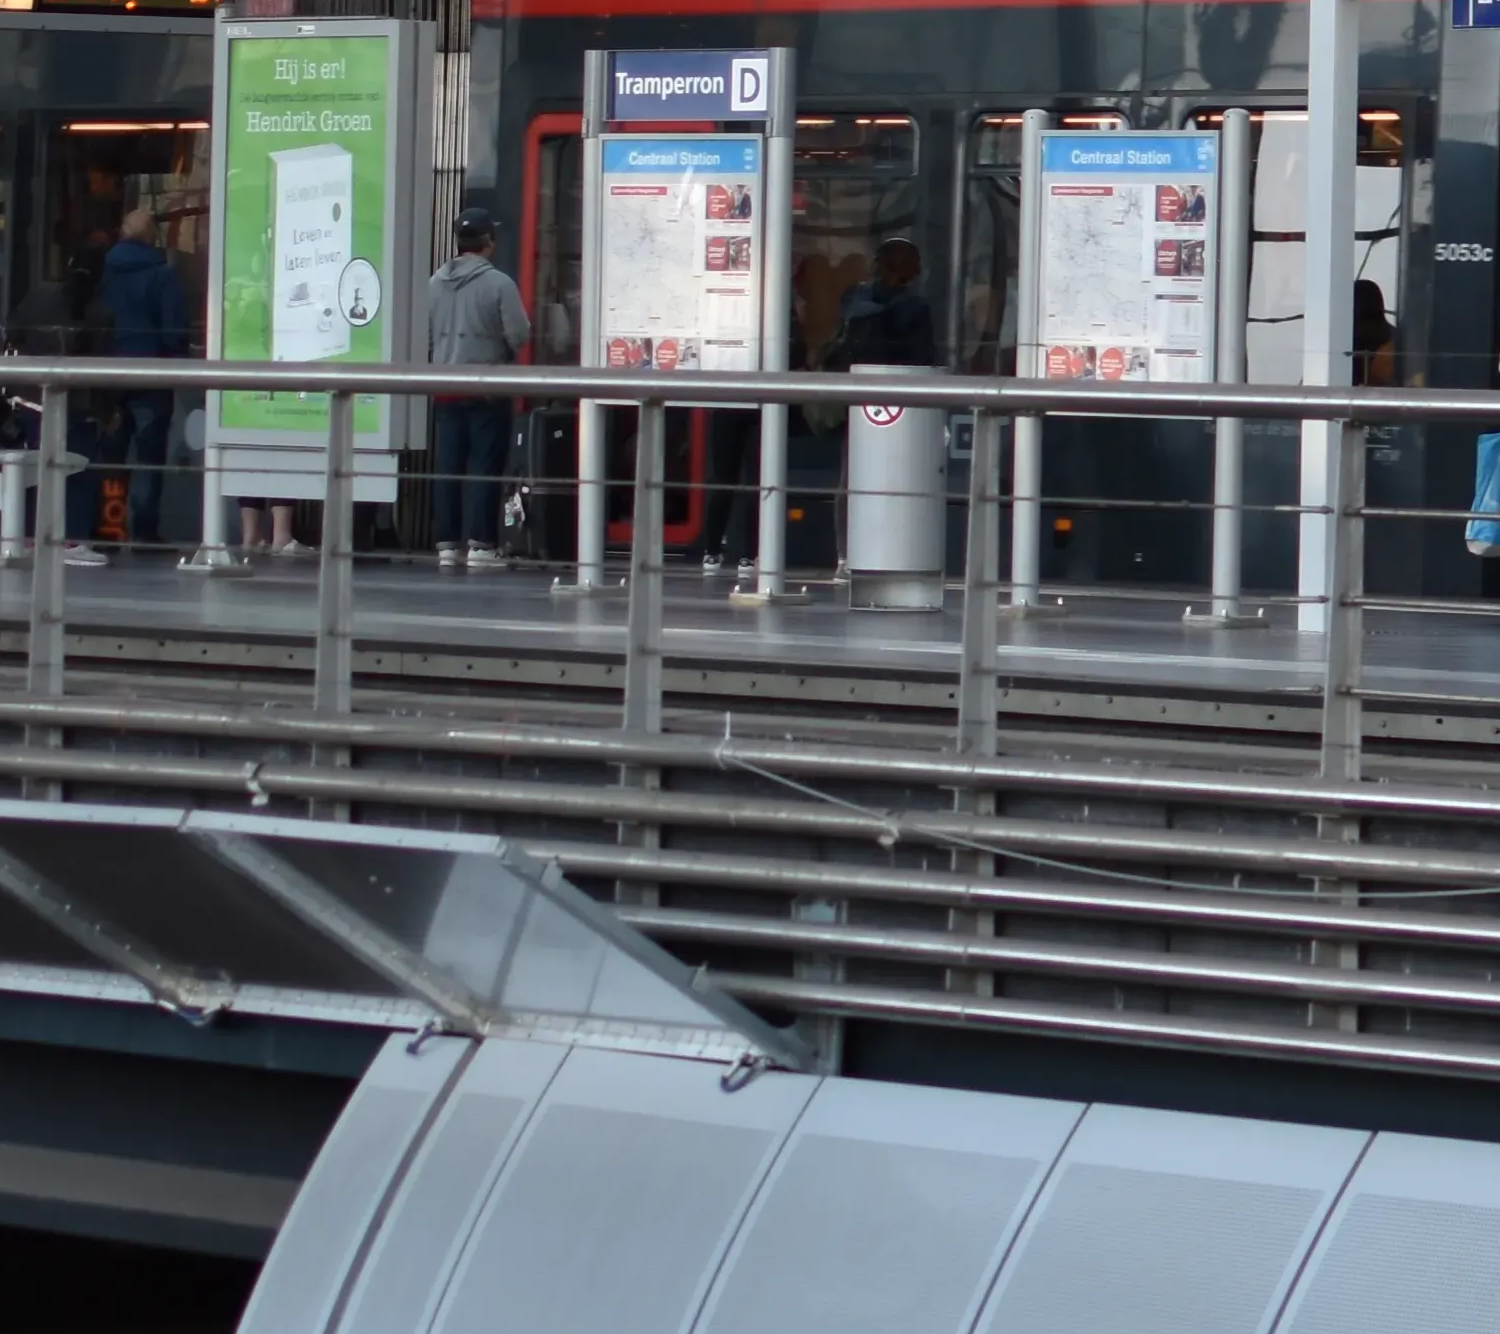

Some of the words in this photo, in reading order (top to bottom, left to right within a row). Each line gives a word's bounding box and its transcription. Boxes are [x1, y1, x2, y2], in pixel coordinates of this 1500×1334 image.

[274, 58, 299, 85] Hij
[303, 59, 317, 80] is
[320, 57, 346, 80] er!
[615, 71, 724, 101] Tramperron
[739, 67, 761, 104] D
[245, 110, 317, 133] Hendrik
[320, 110, 373, 132] Groen
[628, 151, 677, 166] Centraal
[679, 150, 721, 166] Station
[1071, 149, 1124, 165] Centraal
[1127, 149, 1172, 165] Station
[1434, 243, 1494, 263] 5053c
